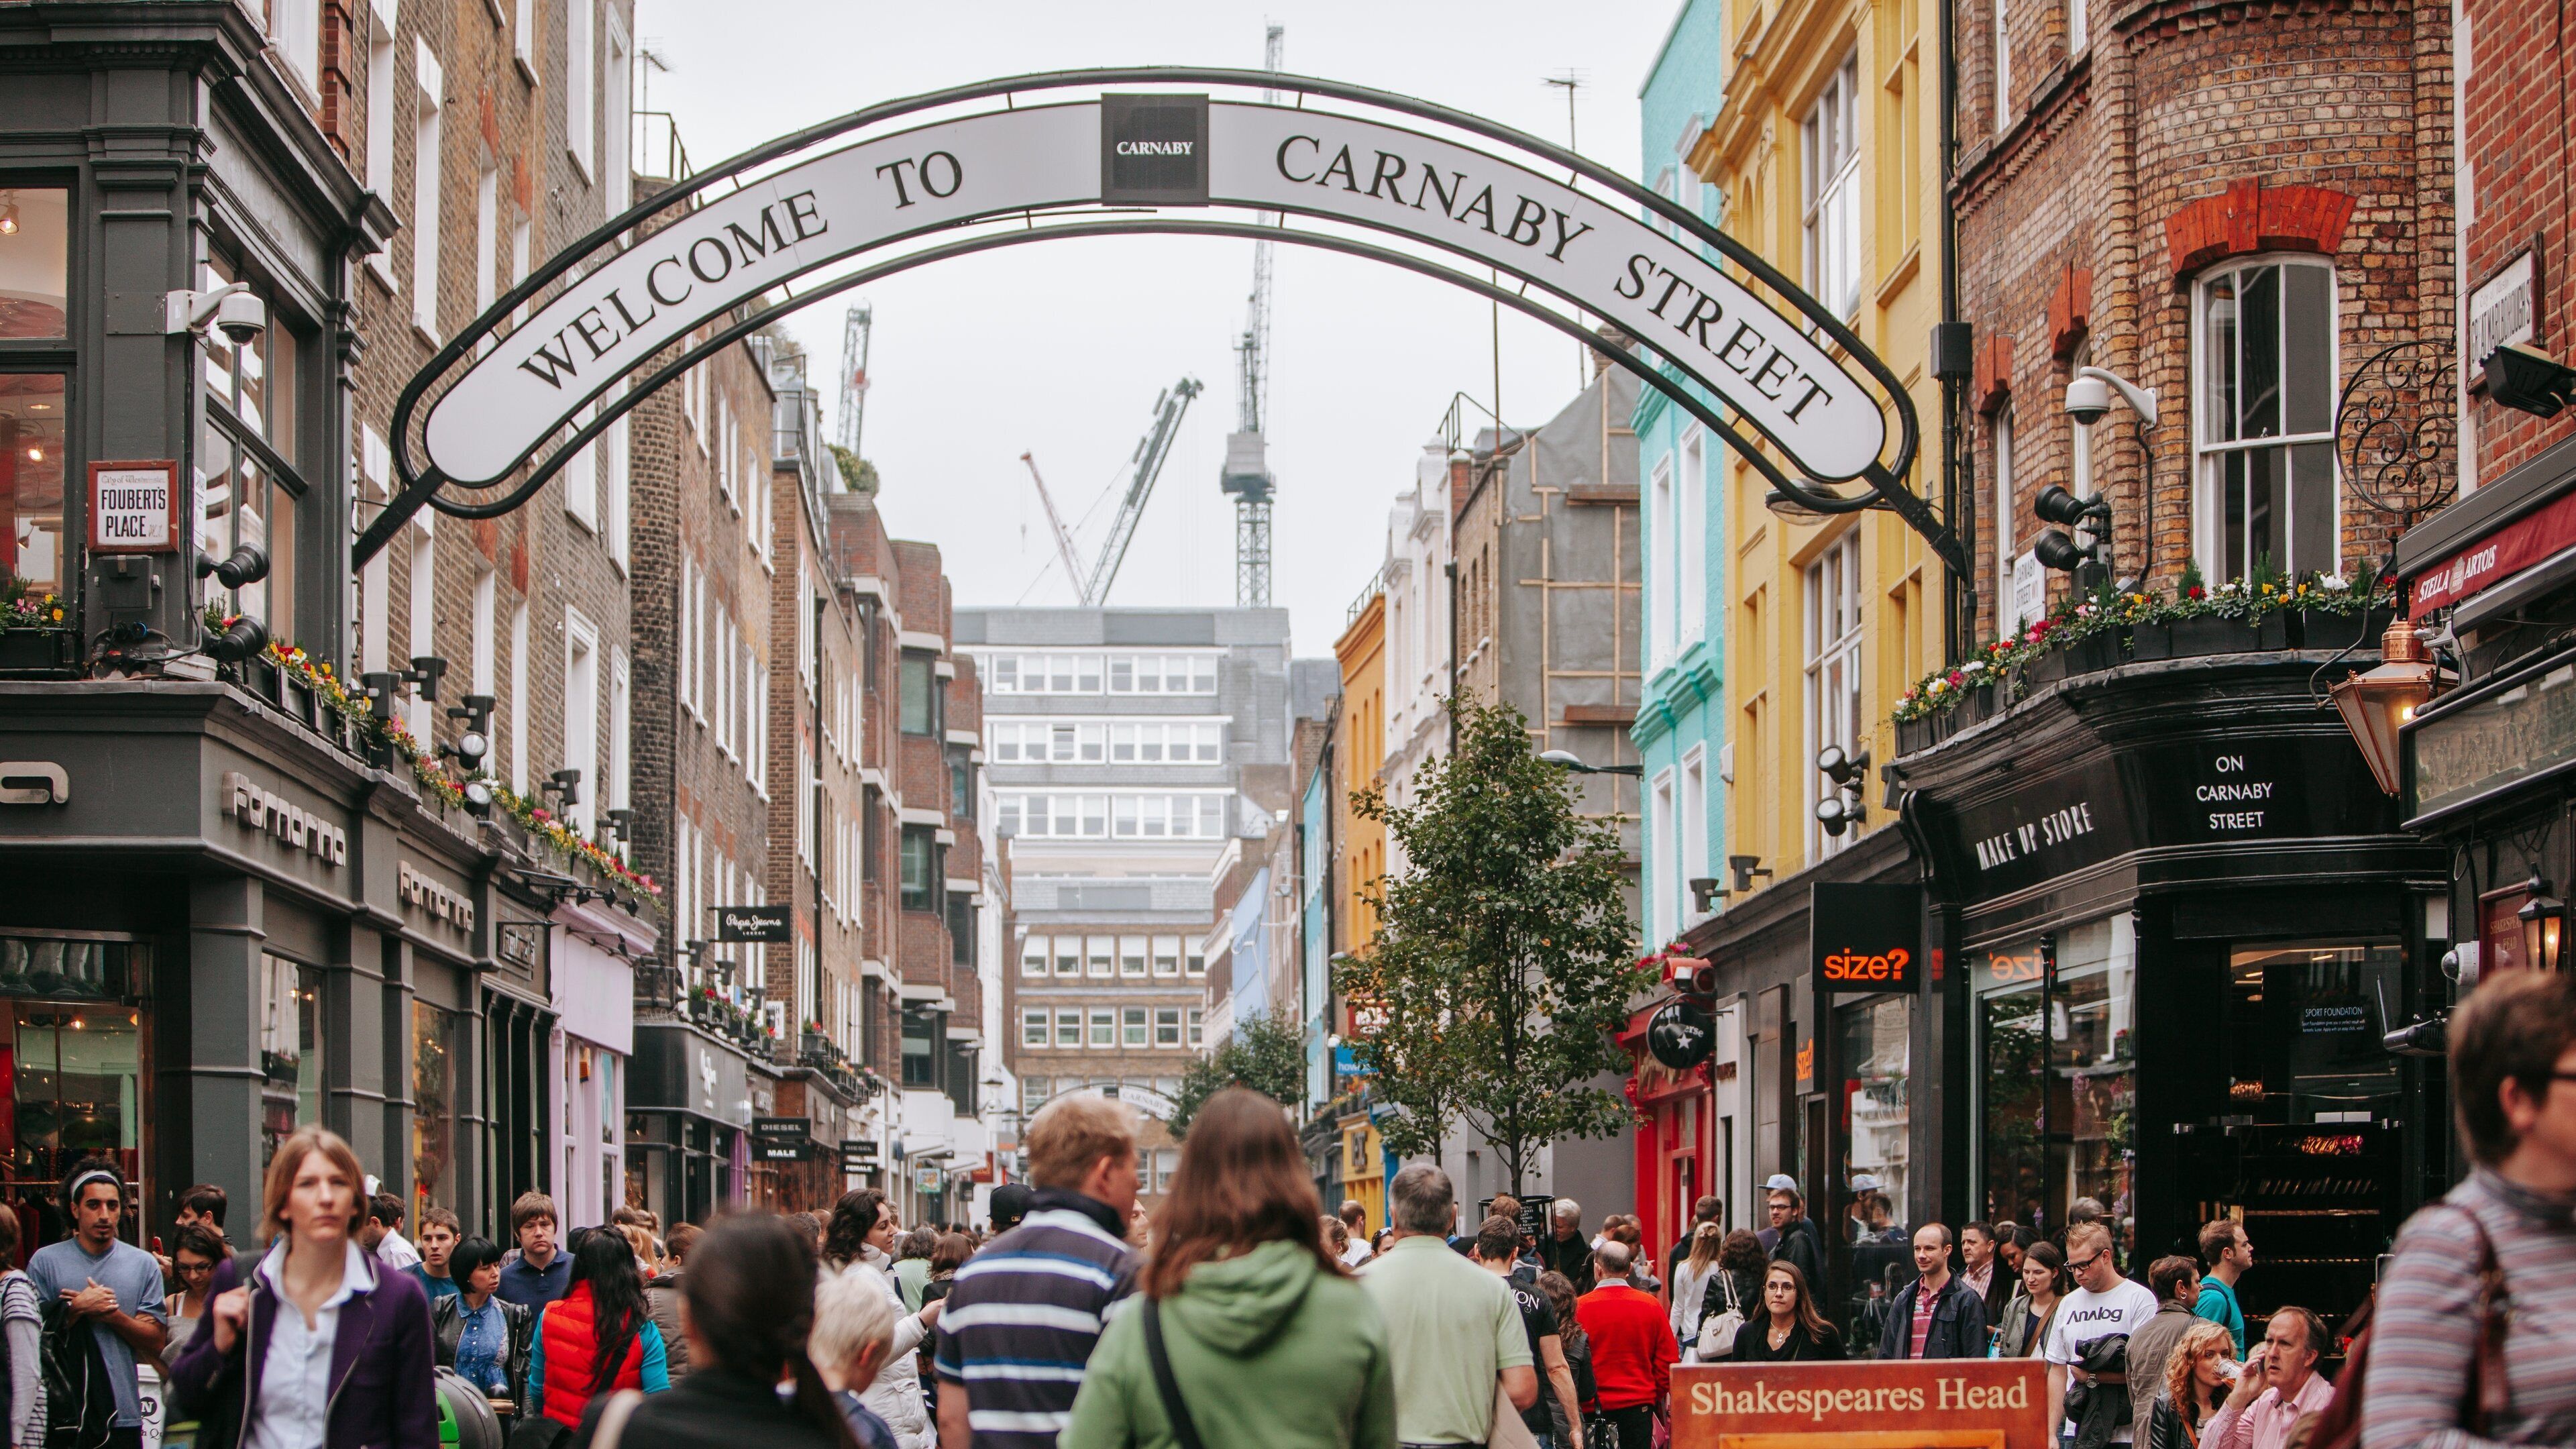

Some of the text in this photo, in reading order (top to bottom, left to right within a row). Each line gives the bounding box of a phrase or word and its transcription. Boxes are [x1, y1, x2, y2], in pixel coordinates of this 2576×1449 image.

[1116, 141, 1193, 156] CARNABY
[517, 151, 963, 390] WELCOME TO
[1276, 135, 1833, 425] CARNABY STREET
[101, 486, 166, 510] FOUBERT'S
[106, 515, 146, 537] PLACE
[2418, 570, 2450, 603] STELLA
[2463, 544, 2497, 580] ARTOIS
[2017, 583, 2031, 608] STREET
[2216, 755, 2243, 773] ON
[2196, 782, 2273, 802] CARNABY
[2209, 811, 2264, 829] STREET
[1976, 802, 2094, 871] MAKE UP STORE
[726, 914, 782, 930] Pepe Jeans
[1824, 947, 1910, 981] size?
[2305, 1006, 2363, 1017] SPORT FOUNDATION
[761, 1124, 802, 1132] DIESEL
[767, 1149, 797, 1158] MALE
[1690, 1375, 2029, 1421] Shakespeares Head
